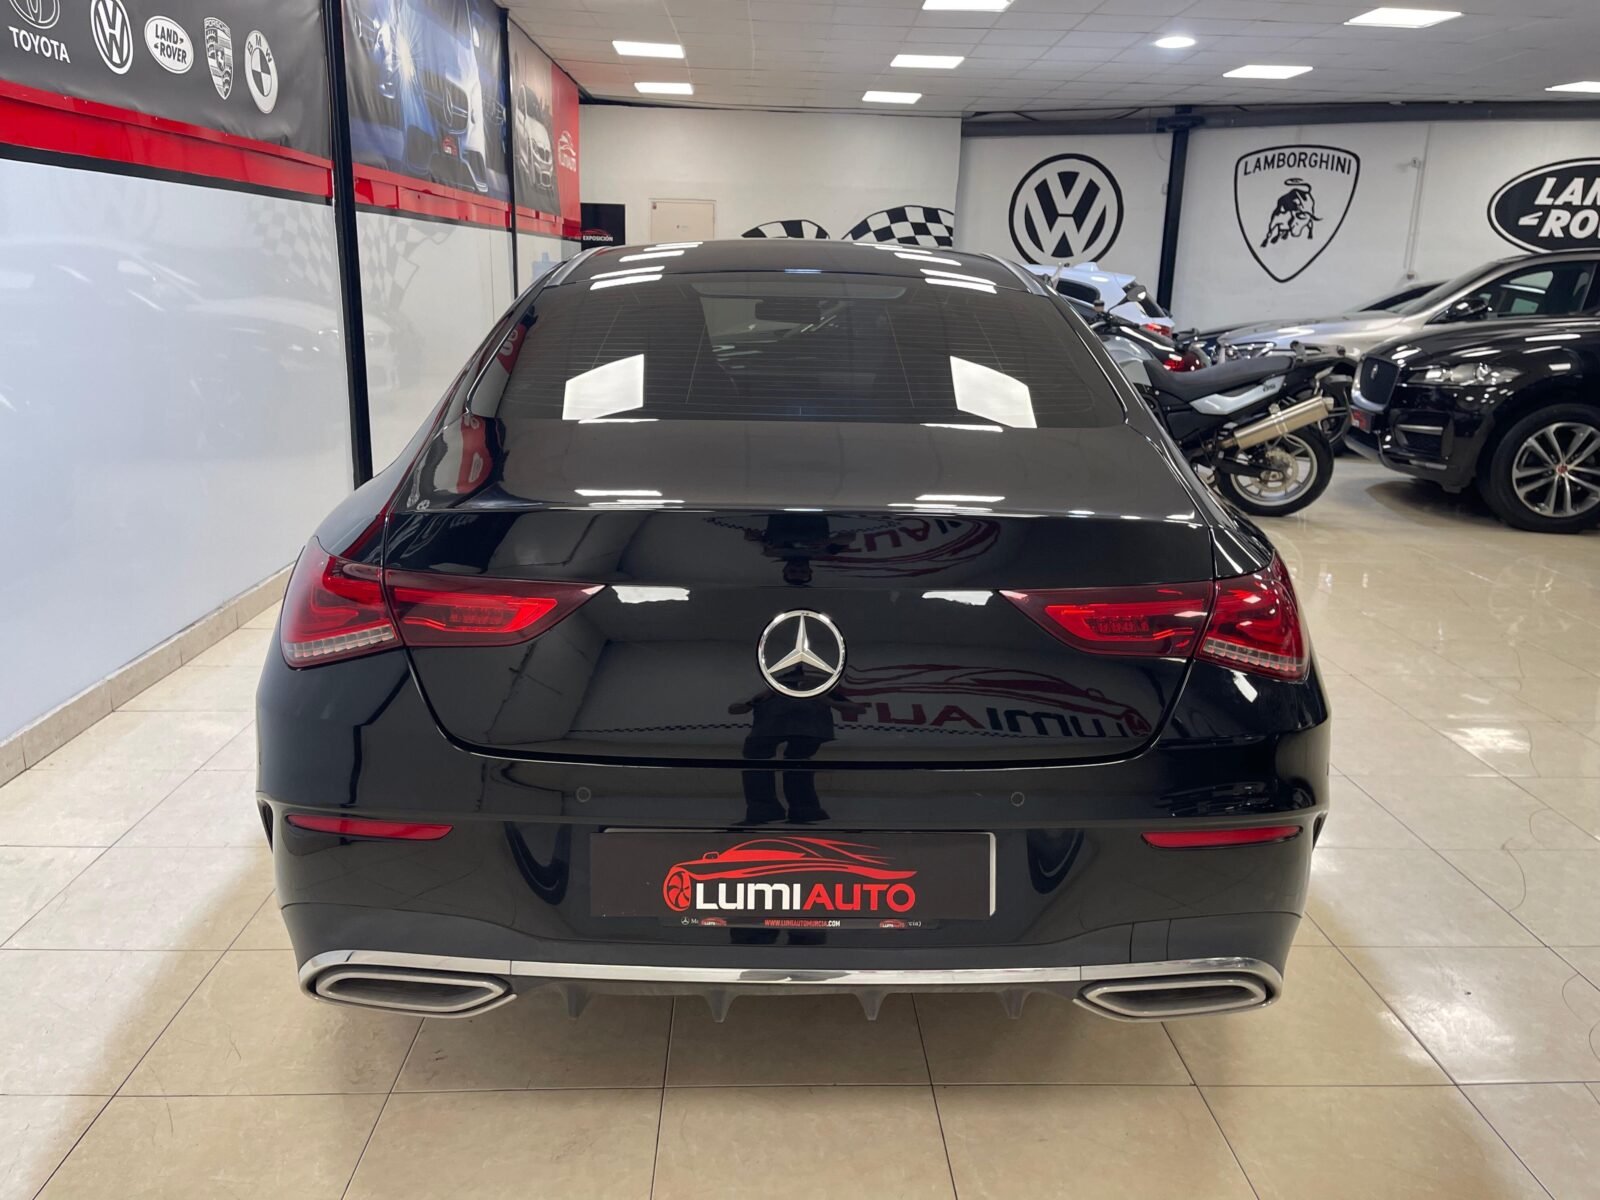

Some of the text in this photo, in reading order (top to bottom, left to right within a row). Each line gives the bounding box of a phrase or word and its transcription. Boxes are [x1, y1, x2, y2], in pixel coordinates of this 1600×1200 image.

[8, 26, 71, 64] TOYOTA
[155, 24, 179, 45] LAND
[247, 34, 273, 63] BMW
[160, 45, 187, 64] ROVER
[1243, 152, 1352, 176] LAMBORGHINI
[1538, 209, 1600, 239] RO
[696, 883, 916, 913] LUMIAUTO
